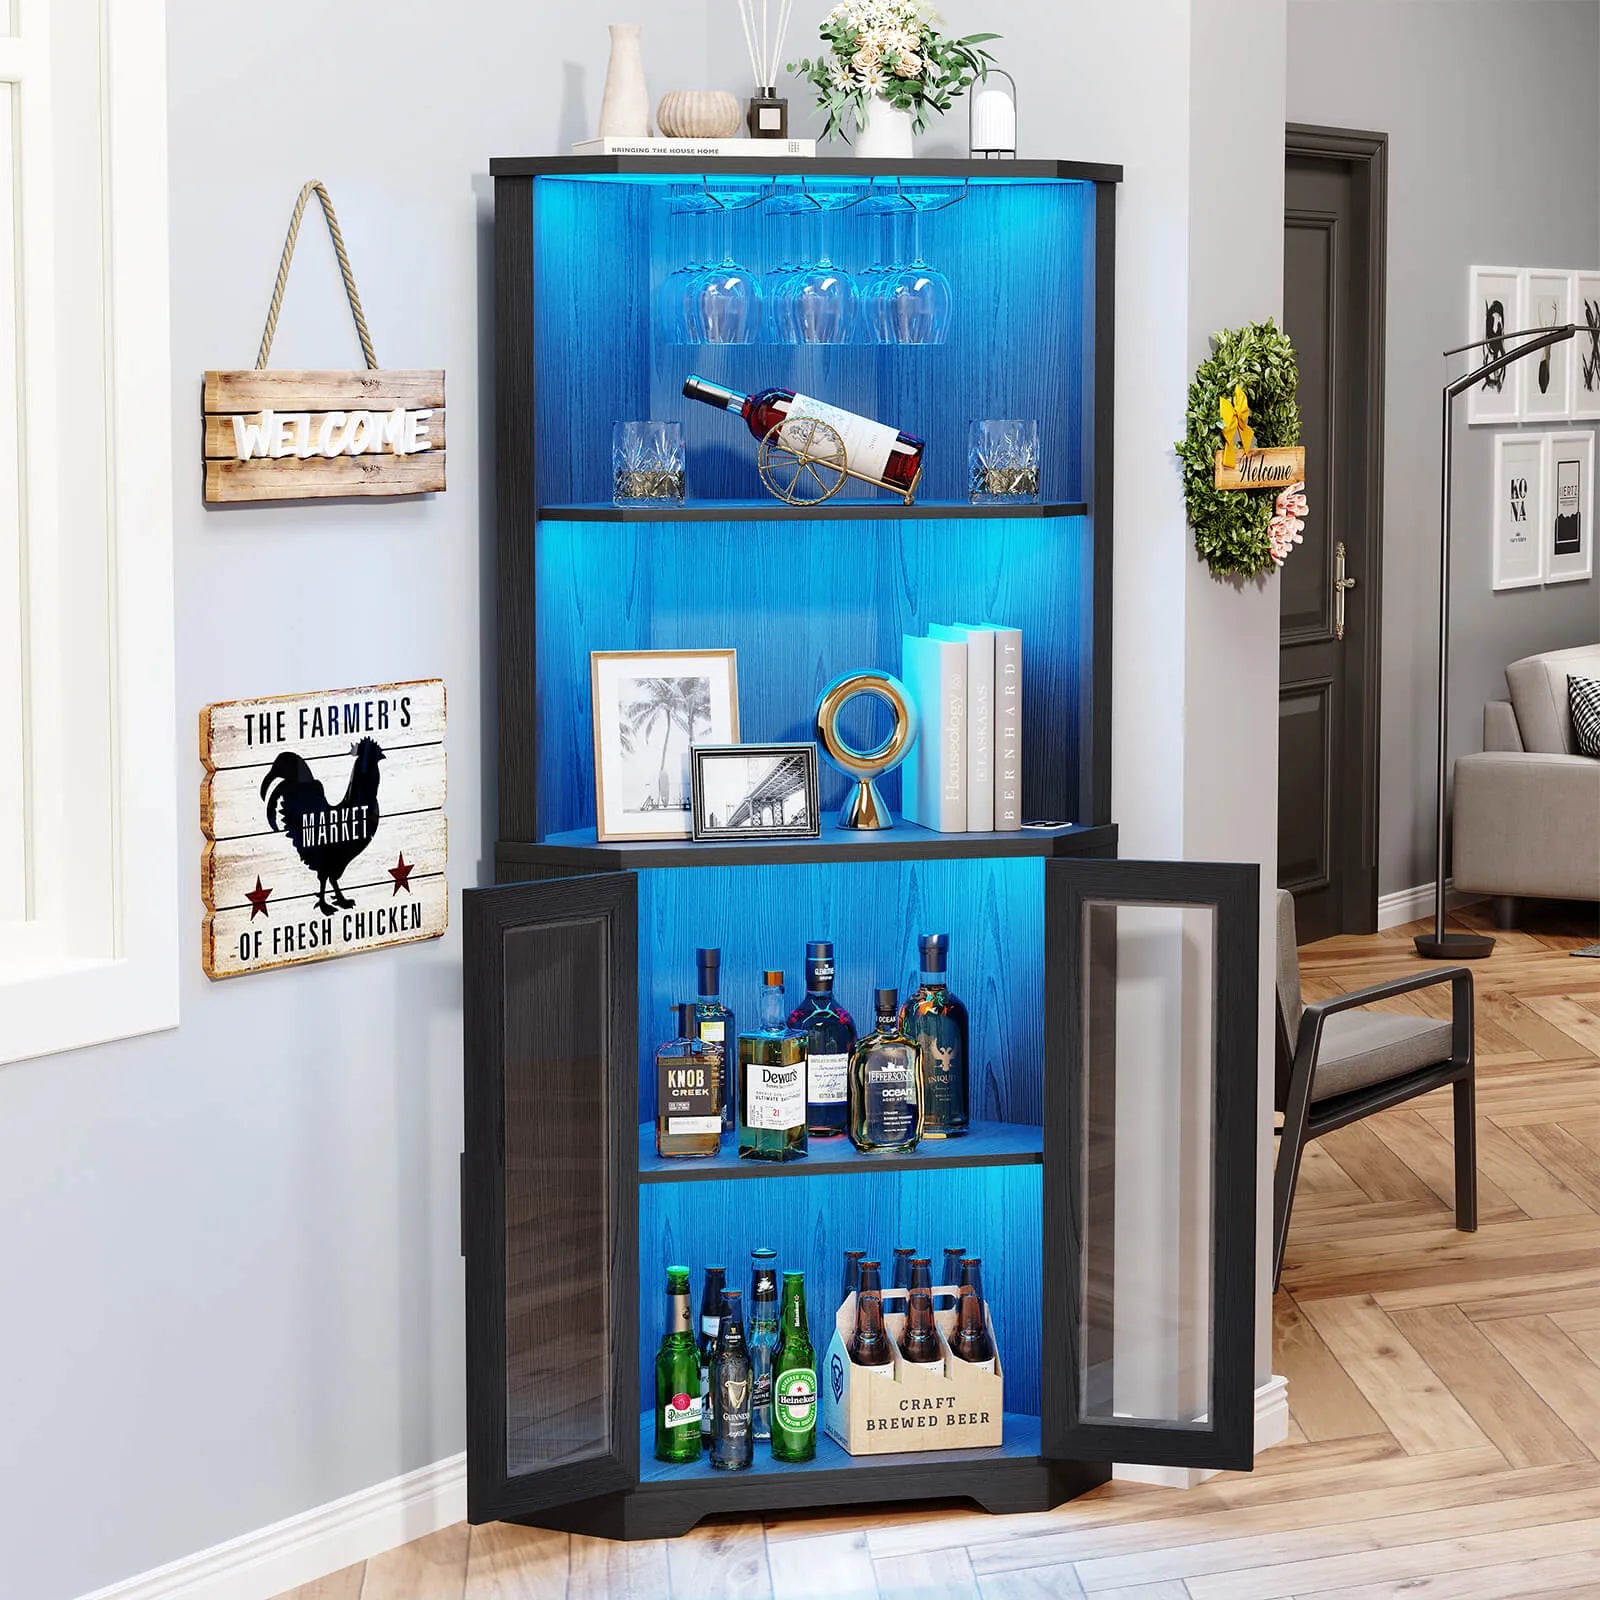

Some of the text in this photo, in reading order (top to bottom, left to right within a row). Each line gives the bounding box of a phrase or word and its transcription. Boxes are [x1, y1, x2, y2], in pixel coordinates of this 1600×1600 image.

[232, 407, 433, 461] WELCOME
[1240, 453, 1293, 483] Welcome
[1510, 478, 1527, 500] KO
[1510, 501, 1527, 522] NA
[244, 697, 411, 745] THE FARMER'S
[945, 694, 964, 801] Houseology
[302, 805, 369, 848] MARKET
[240, 902, 422, 961] OF FRESH CHICKEN
[668, 1069, 705, 1088] KNOB
[762, 1069, 798, 1084] Dewar's
[671, 1088, 709, 1097] CREEK
[773, 1108, 780, 1117] 21
[899, 1397, 956, 1411] CRAFT
[866, 1412, 990, 1431] BREWED BEER
